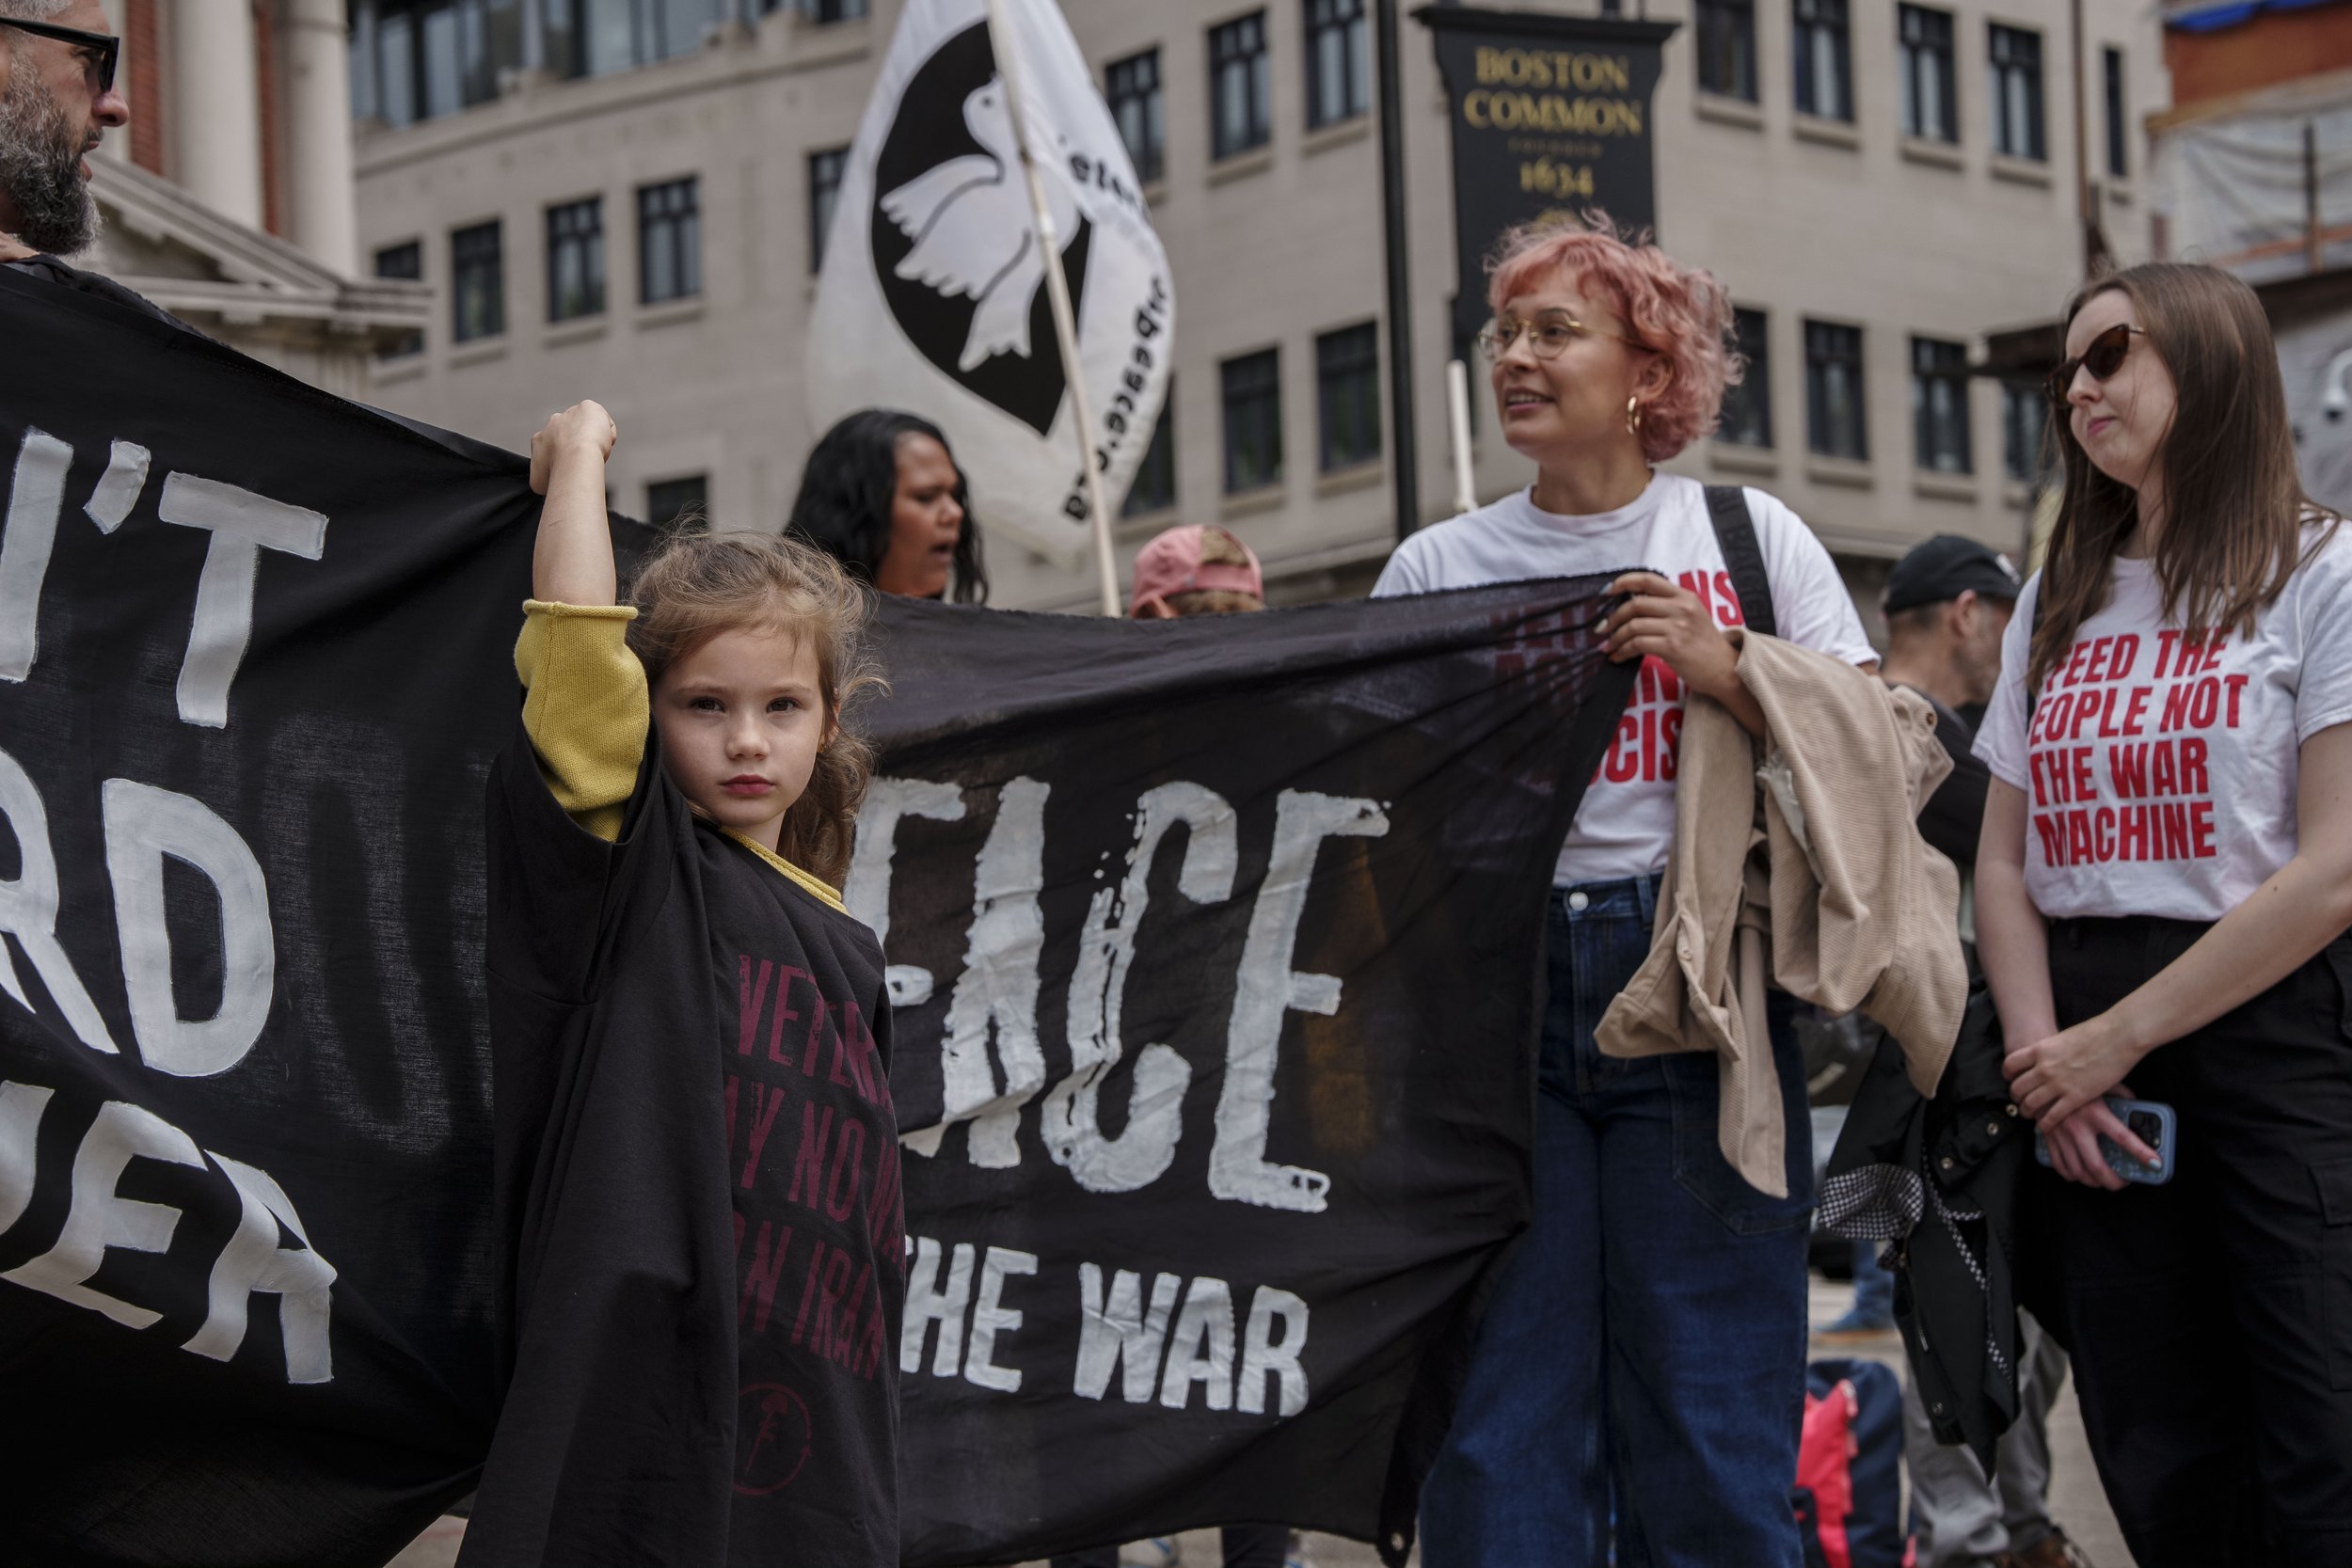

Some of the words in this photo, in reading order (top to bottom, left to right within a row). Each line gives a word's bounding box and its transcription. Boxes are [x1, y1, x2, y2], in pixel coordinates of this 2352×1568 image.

[1475, 46, 1629, 92] BOSTON
[1464, 88, 1643, 136] COMMON
[1520, 155, 1594, 199] 1634
[2153, 626, 2234, 679] THE
[2159, 673, 2249, 733] NOT
[1591, 707, 1684, 784] CIS
[2029, 747, 2097, 807] THE
[2109, 737, 2209, 798] WAR
[2034, 801, 2217, 867] MACHINE
[788, 1099, 866, 1221] NO
[790, 1240, 884, 1381] IRAN
[899, 1235, 1039, 1393] HE
[1073, 1262, 1310, 1418] WAR
